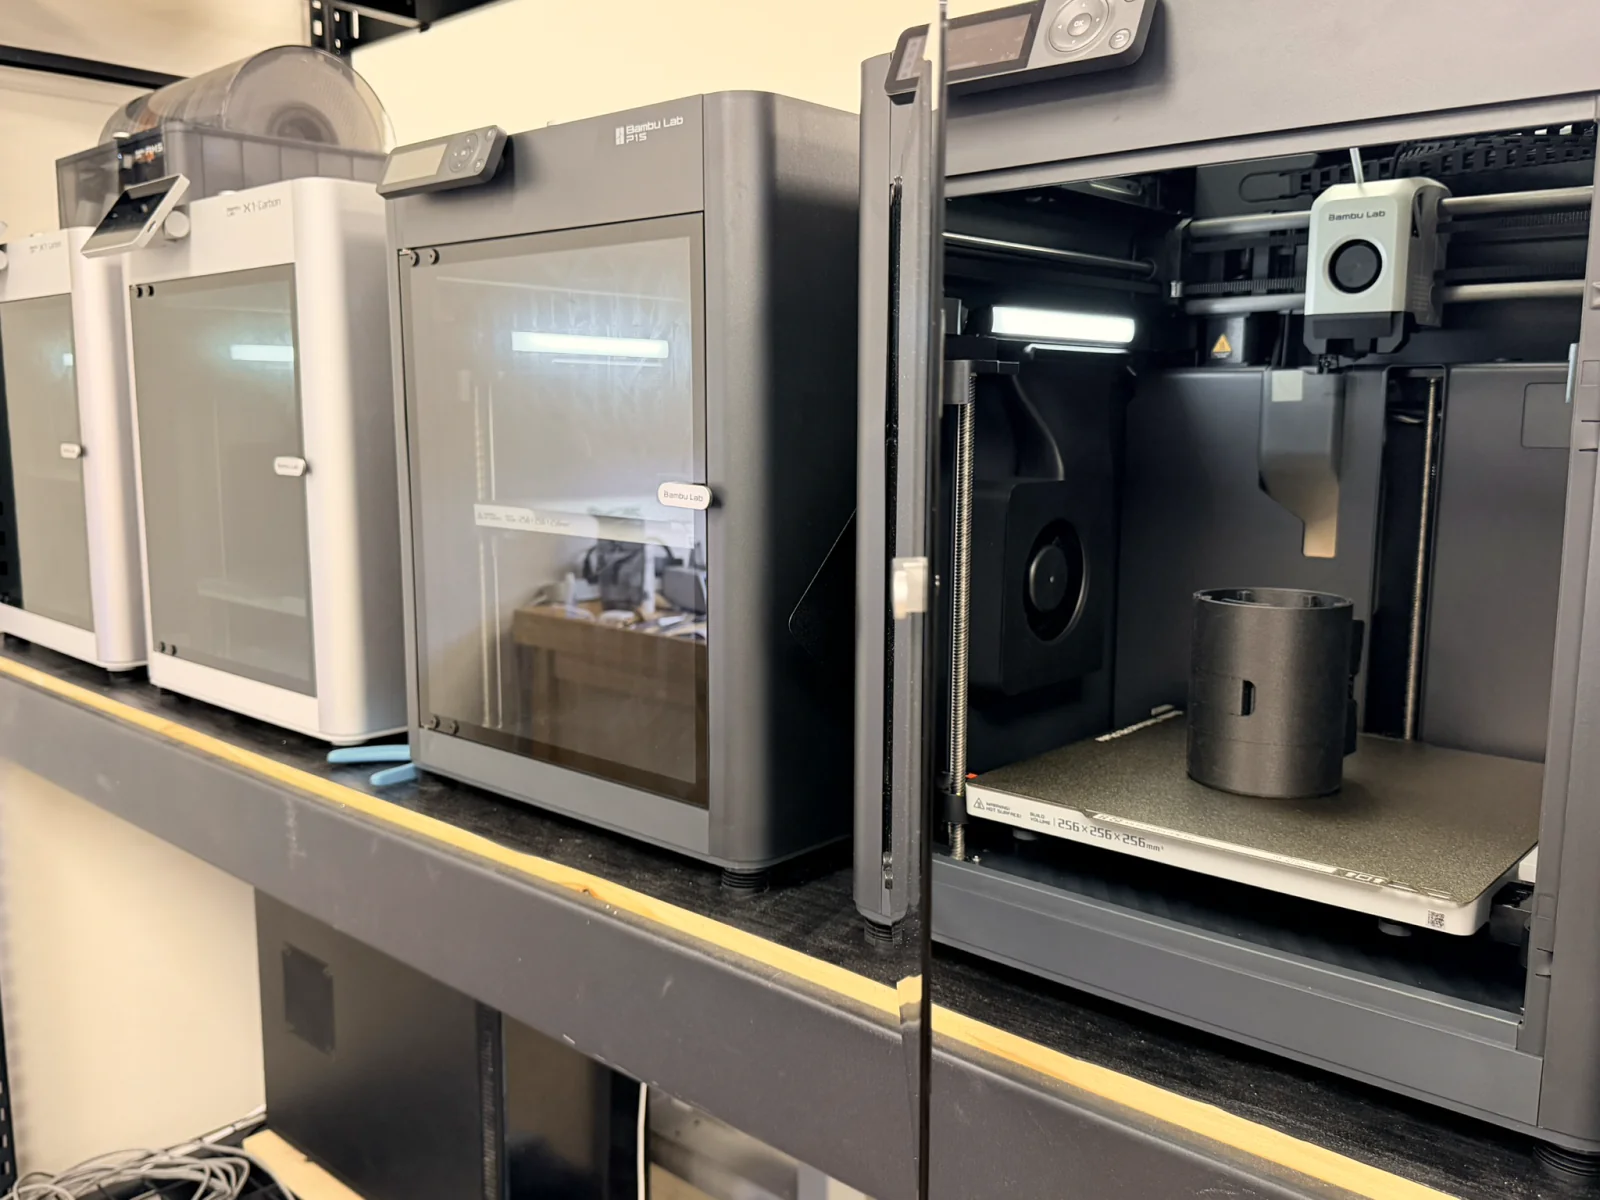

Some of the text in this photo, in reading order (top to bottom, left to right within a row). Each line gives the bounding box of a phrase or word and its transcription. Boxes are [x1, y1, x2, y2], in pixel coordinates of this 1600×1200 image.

[626, 115, 684, 135] Bambu Lab
[626, 132, 647, 144] P1S
[1328, 210, 1386, 222] Bambu Lab
[663, 489, 704, 502] Bambu Lab
